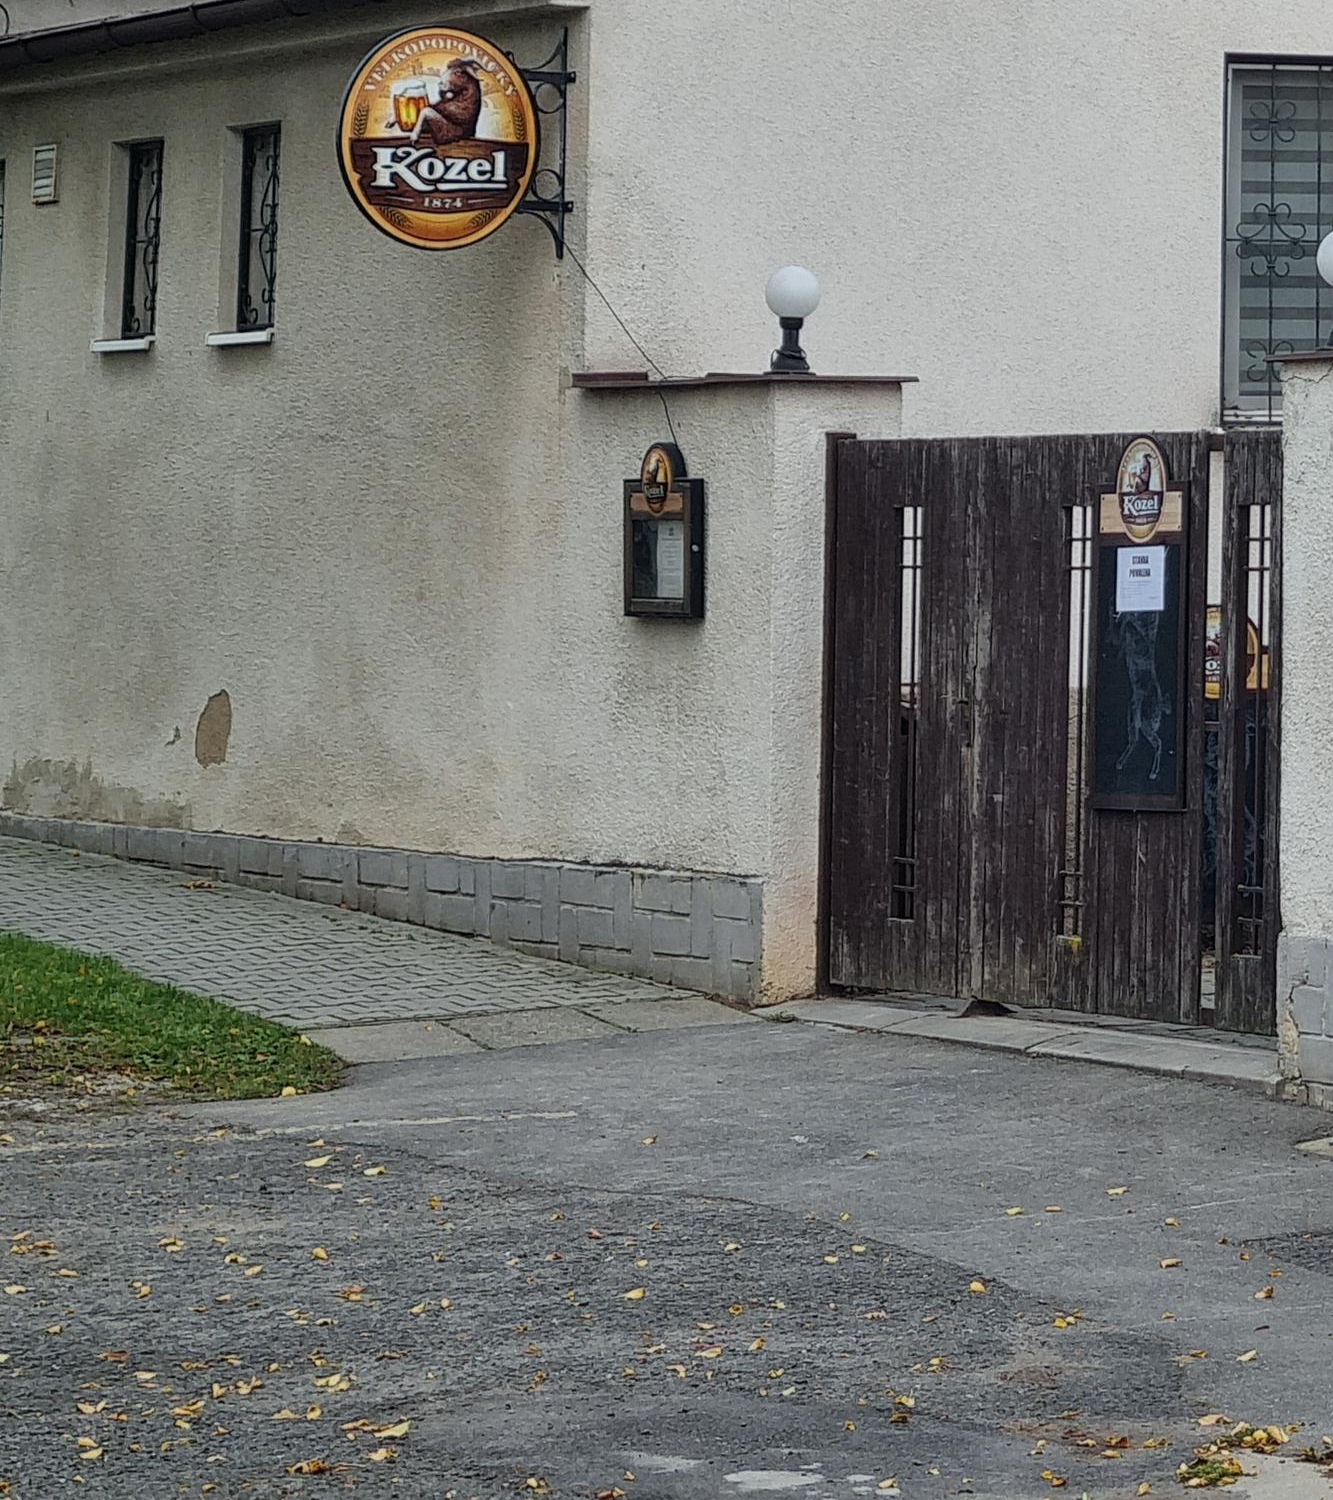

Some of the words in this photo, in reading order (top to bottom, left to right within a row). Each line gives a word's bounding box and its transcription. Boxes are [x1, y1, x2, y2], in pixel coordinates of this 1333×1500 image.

[370, 145, 508, 192] Kozel
[423, 196, 463, 209] 1874
[1123, 495, 1159, 516] Kozel
